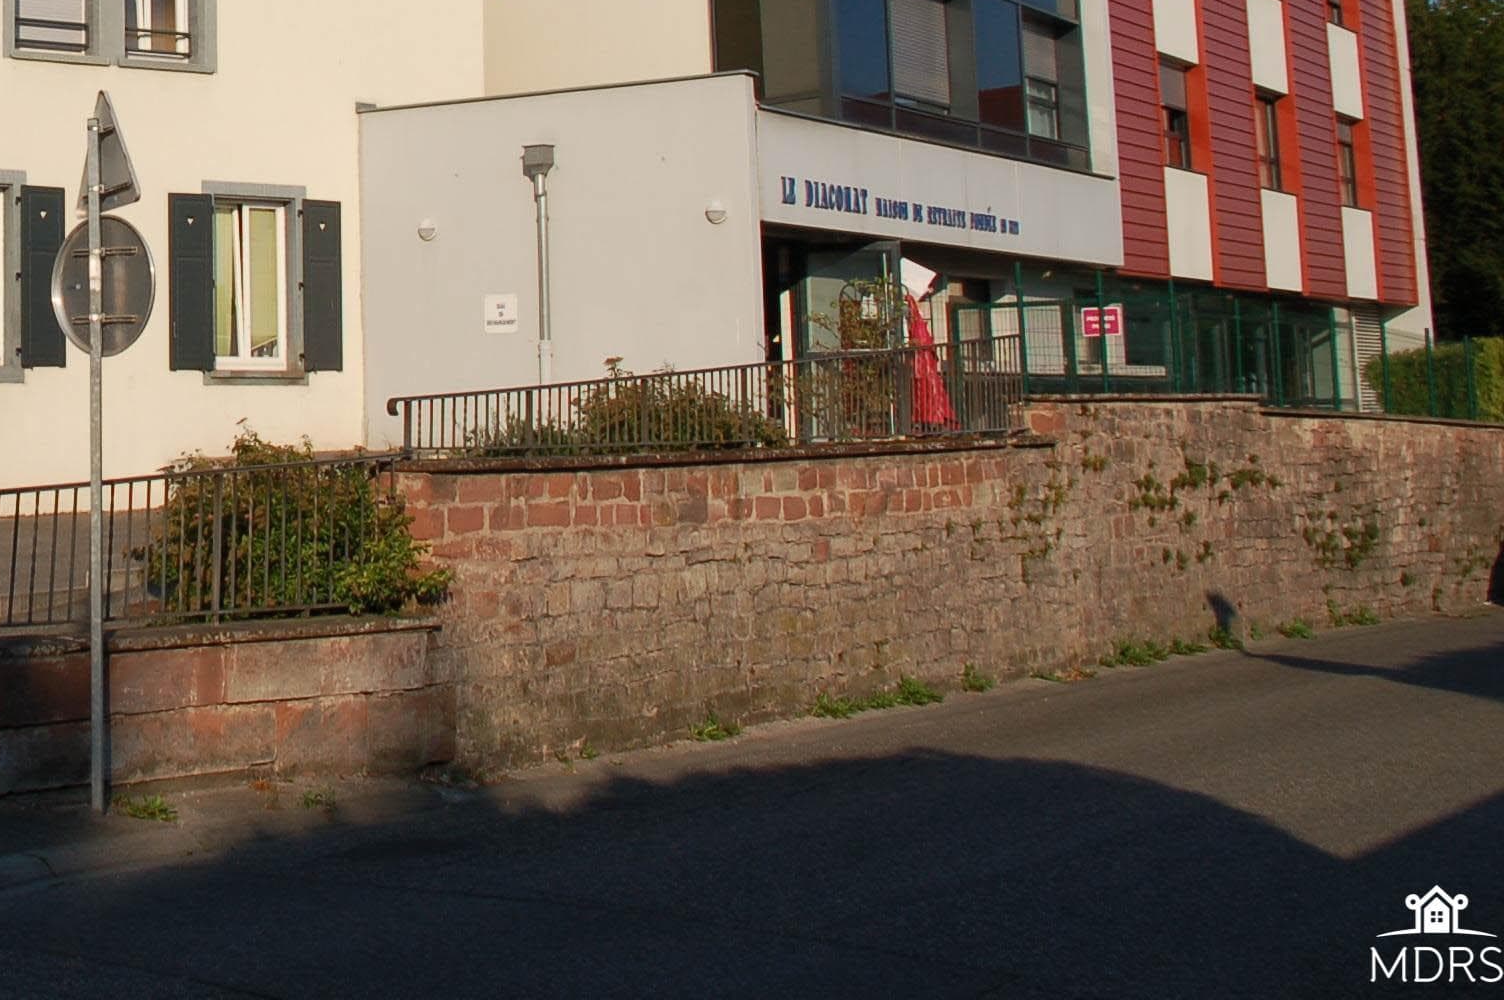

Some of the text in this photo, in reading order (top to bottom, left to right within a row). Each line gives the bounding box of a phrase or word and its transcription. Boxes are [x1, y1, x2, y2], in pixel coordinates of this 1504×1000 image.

[780, 176, 796, 205] LE
[804, 179, 868, 215] DIACONAT
[875, 197, 908, 221] MAISON
[912, 203, 923, 223] DE
